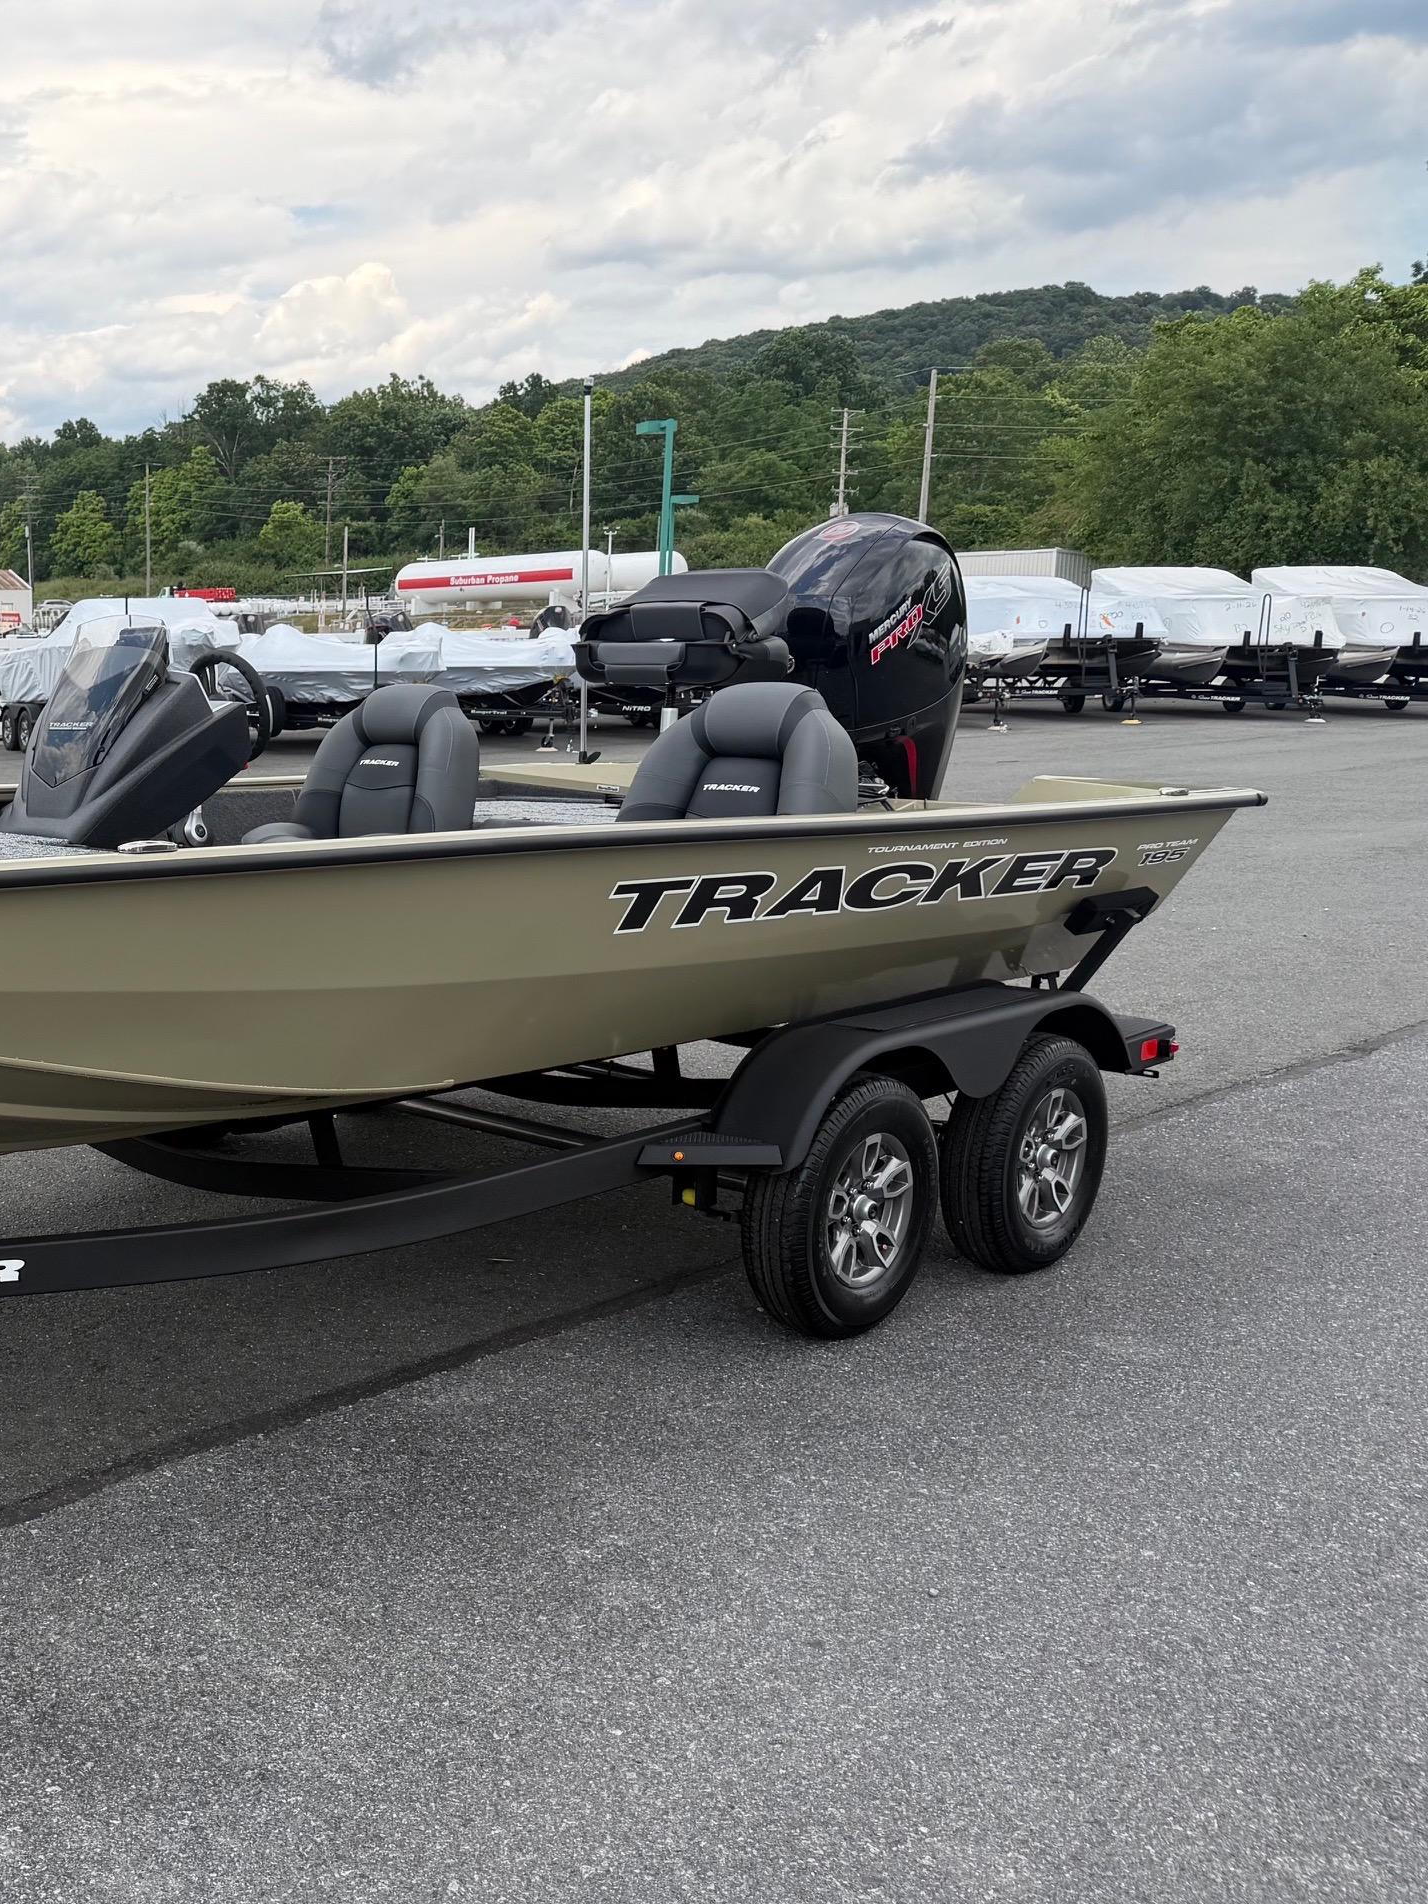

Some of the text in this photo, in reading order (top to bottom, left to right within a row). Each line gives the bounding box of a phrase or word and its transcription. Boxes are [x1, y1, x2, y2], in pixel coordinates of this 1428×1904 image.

[449, 574, 519, 586] Suburban Propane
[869, 596, 912, 644] MERCURY
[871, 603, 923, 665] PRO
[359, 758, 400, 767] TRACKER
[703, 783, 760, 793] TRACKER
[867, 838, 1008, 854] TOURNAMENT EDITION
[1136, 838, 1199, 851] PRO TEAM
[1138, 847, 1190, 867] 195
[608, 847, 1118, 935] TRACKER
